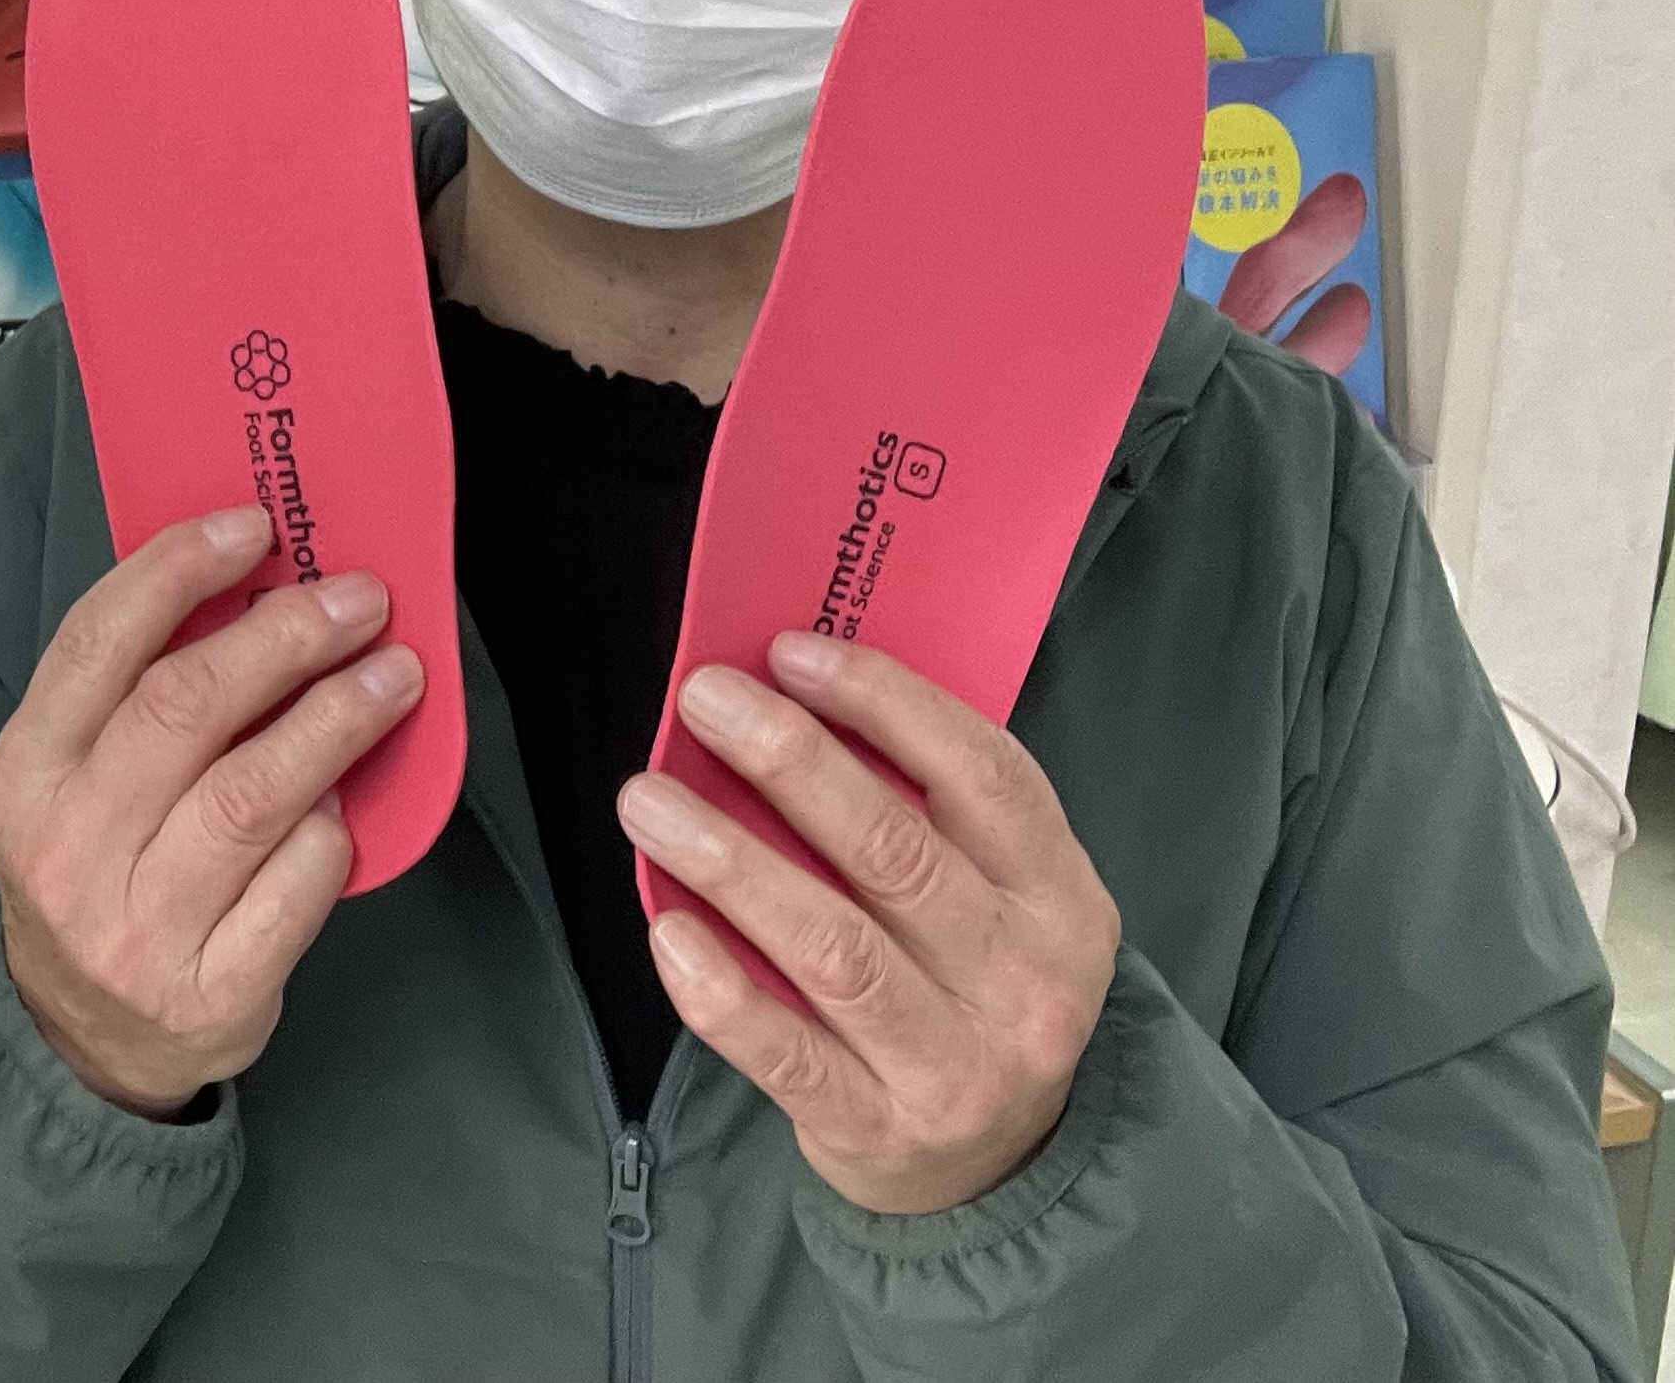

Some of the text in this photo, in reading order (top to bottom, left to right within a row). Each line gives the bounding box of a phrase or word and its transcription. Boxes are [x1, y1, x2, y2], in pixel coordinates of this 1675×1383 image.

[244, 412, 267, 466] Foot
[909, 460, 930, 480] S
[266, 408, 322, 585] Formthot
[812, 430, 899, 638] ormthotics
[850, 520, 896, 611] Science
